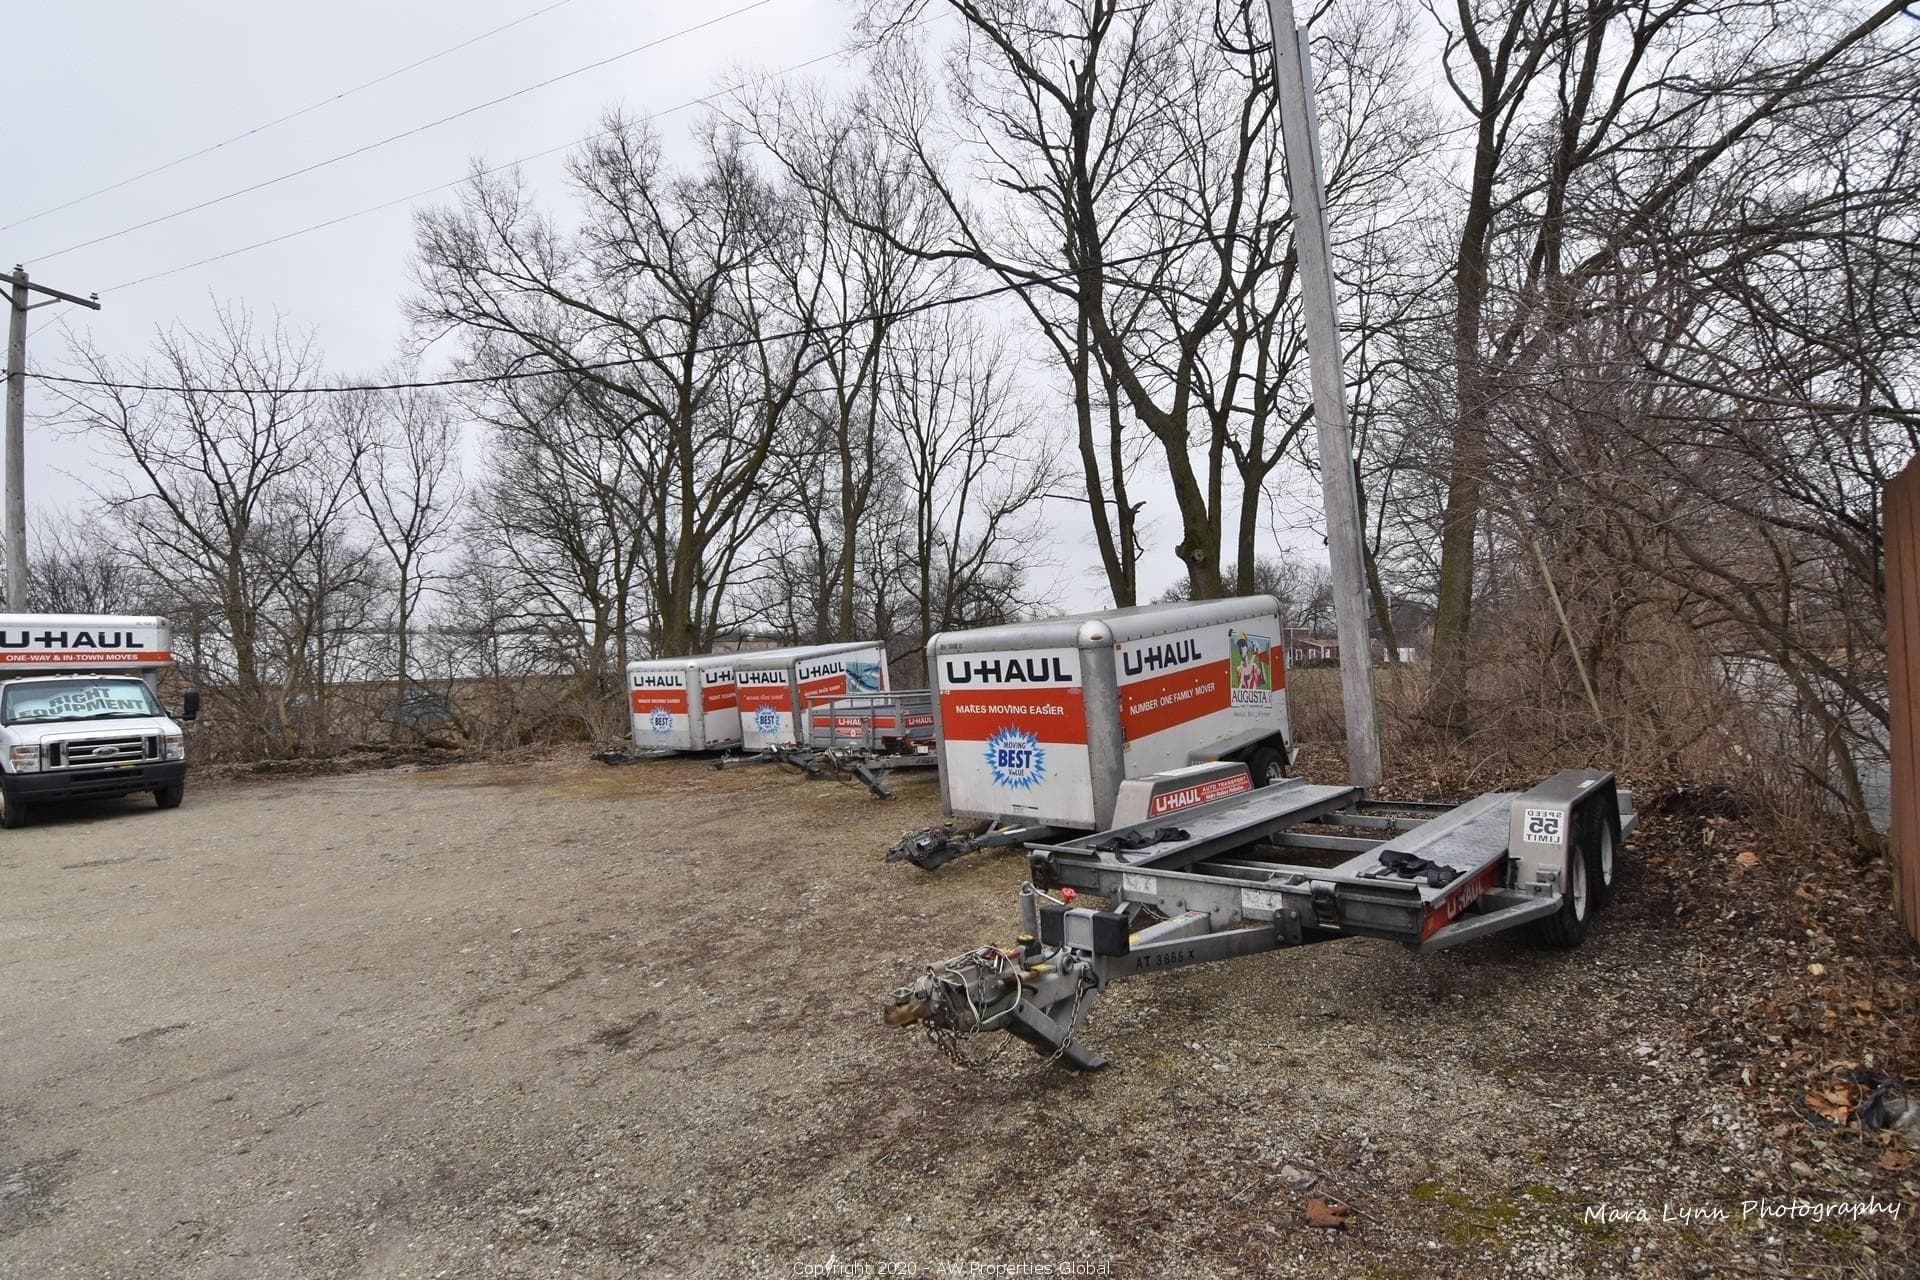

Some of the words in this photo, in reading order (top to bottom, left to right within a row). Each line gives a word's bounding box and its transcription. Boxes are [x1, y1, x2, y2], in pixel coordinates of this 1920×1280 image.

[0, 631, 144, 648] U-HAUL
[6, 654, 50, 662] ONE-WAY
[106, 653, 138, 661] MOVES
[1122, 638, 1202, 676] U-HAUL
[738, 671, 786, 684] U-HAUL
[799, 661, 845, 680] U-HAUL
[946, 657, 1073, 684] U-HAUL
[633, 675, 683, 687] U-HAUL
[50, 687, 111, 708] RIGHT
[1129, 698, 1159, 716] NUMBER
[1159, 694, 1173, 706] ONE
[1173, 688, 1194, 704] FAMILY
[1195, 682, 1216, 696] MOVER
[1232, 690, 1268, 704] AUGUSTA
[956, 704, 987, 714] MAKES
[989, 704, 1027, 714] MOVING
[1029, 704, 1065, 715] EASIER
[655, 717, 669, 726] BEST
[760, 715, 775, 725] BEST
[1004, 742, 1026, 750] MOVING
[998, 749, 1033, 769] BEST
[1155, 788, 1201, 813] U-HAUL
[1135, 955, 1152, 970] AT
